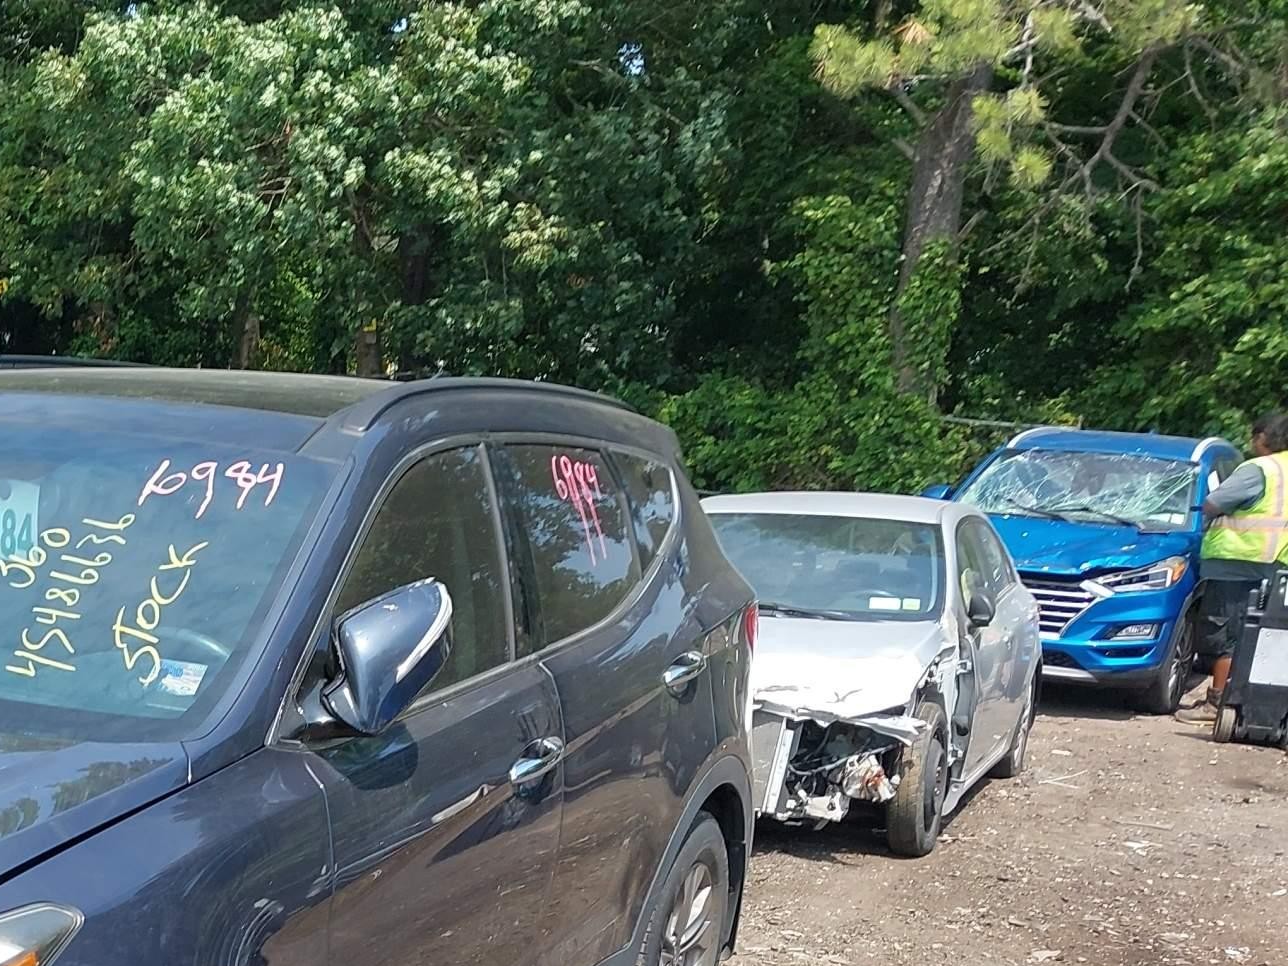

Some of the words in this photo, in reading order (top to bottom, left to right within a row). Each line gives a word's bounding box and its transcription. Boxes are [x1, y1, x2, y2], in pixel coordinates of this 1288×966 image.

[138, 459, 285, 519] 6984
[5, 513, 136, 677] 45486636
[112, 541, 209, 688] STOCK
